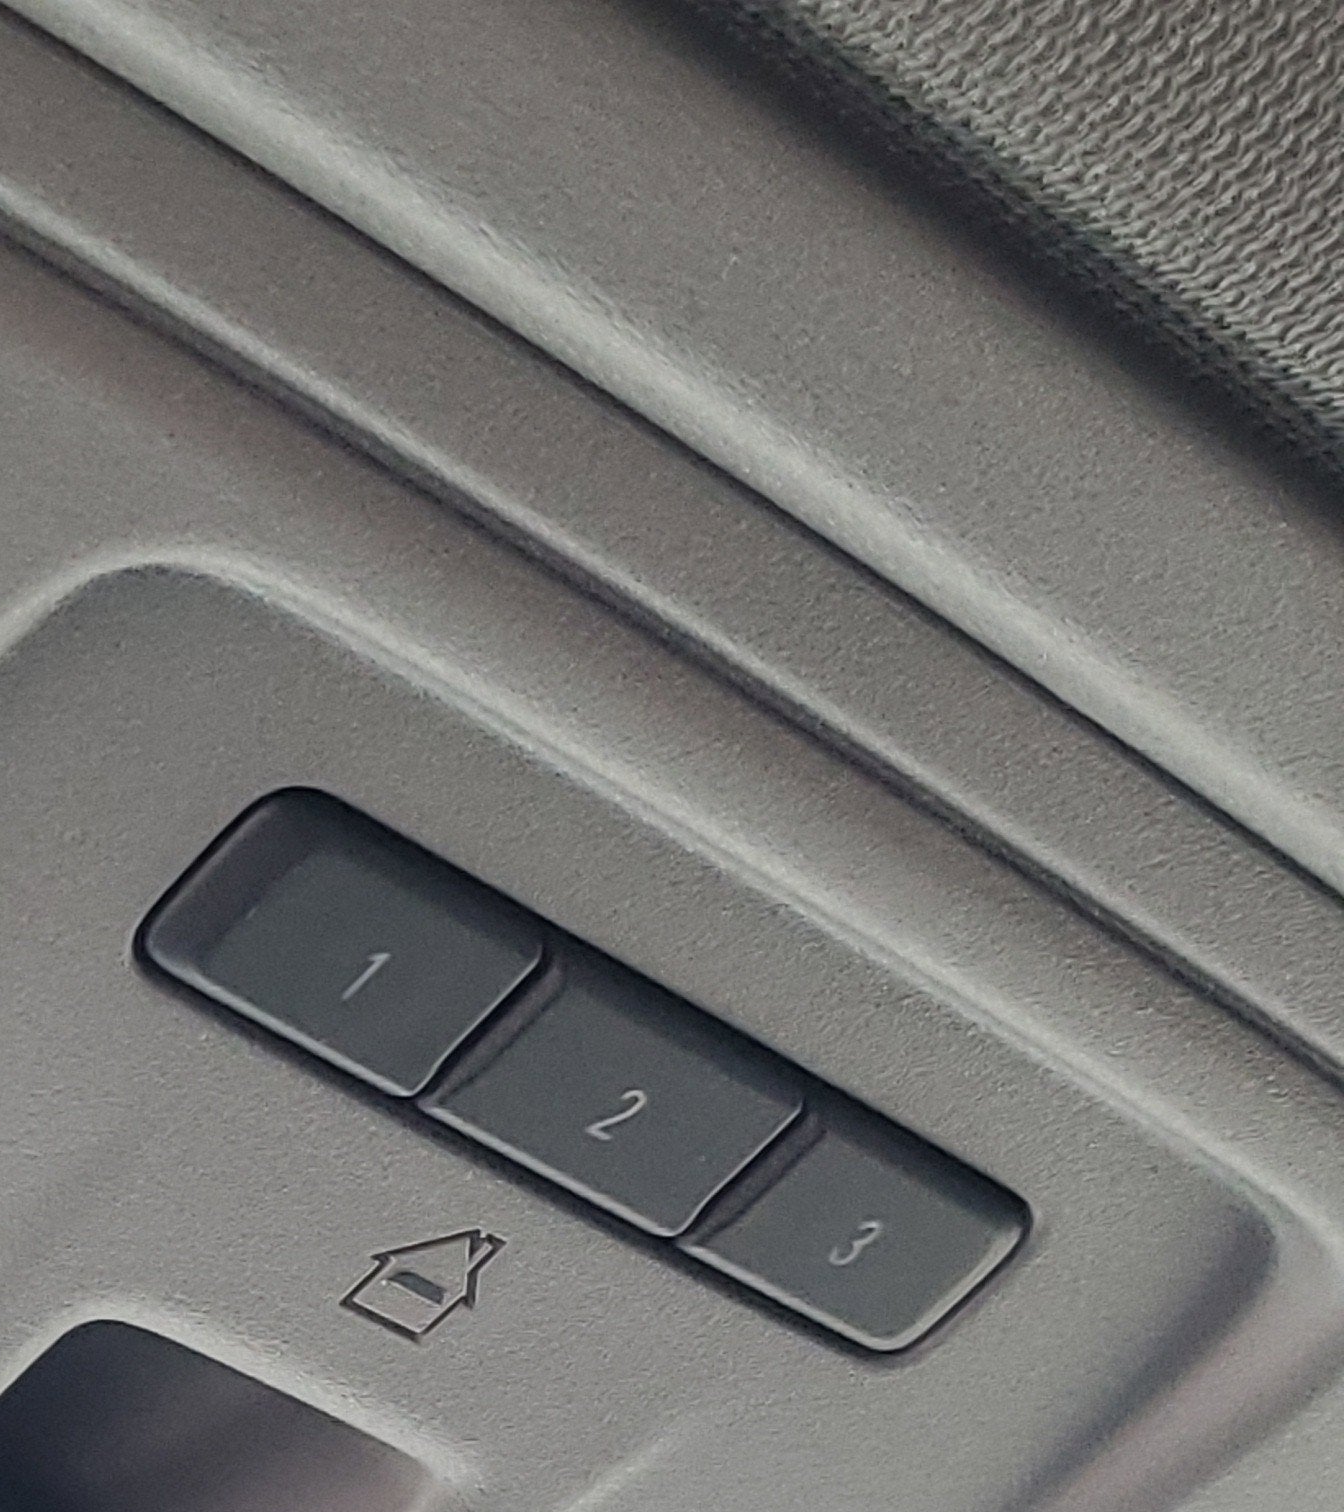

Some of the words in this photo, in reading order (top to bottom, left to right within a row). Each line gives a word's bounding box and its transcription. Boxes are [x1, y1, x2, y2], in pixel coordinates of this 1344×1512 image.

[342, 950, 393, 999] 1
[584, 1088, 648, 1141] 2
[829, 1219, 882, 1268] 3
